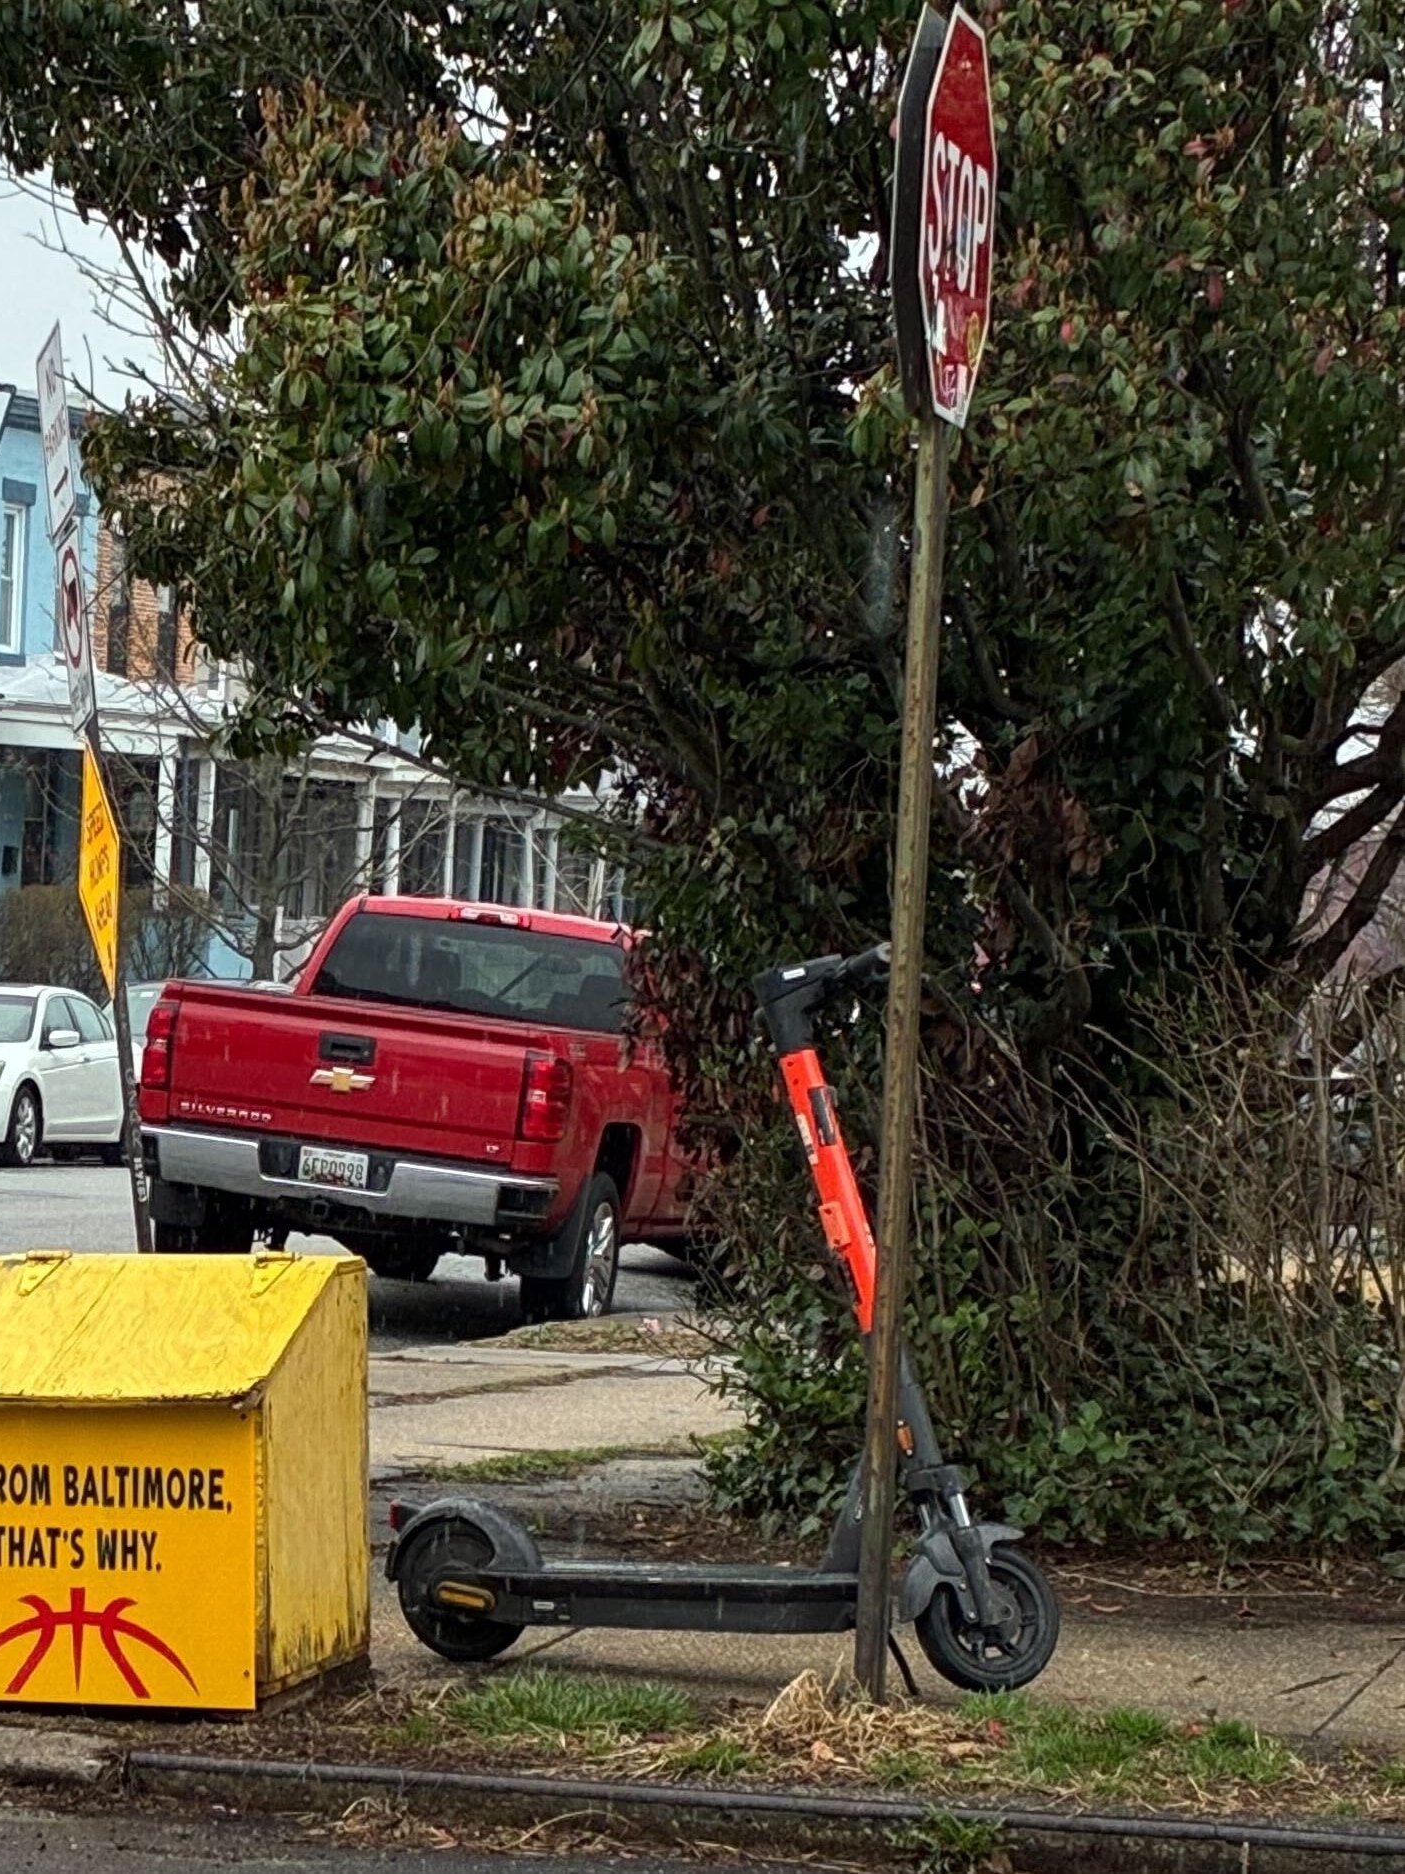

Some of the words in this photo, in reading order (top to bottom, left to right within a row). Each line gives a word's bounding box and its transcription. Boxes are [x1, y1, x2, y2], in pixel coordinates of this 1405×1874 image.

[927, 131, 990, 299] STOP
[86, 801, 104, 844] SPEED
[89, 843, 111, 889] HUMPS
[180, 1101, 272, 1121] SILVERADO
[63, 1465, 233, 1514] BALTIMORE,
[96, 1528, 162, 1573] WHY.
